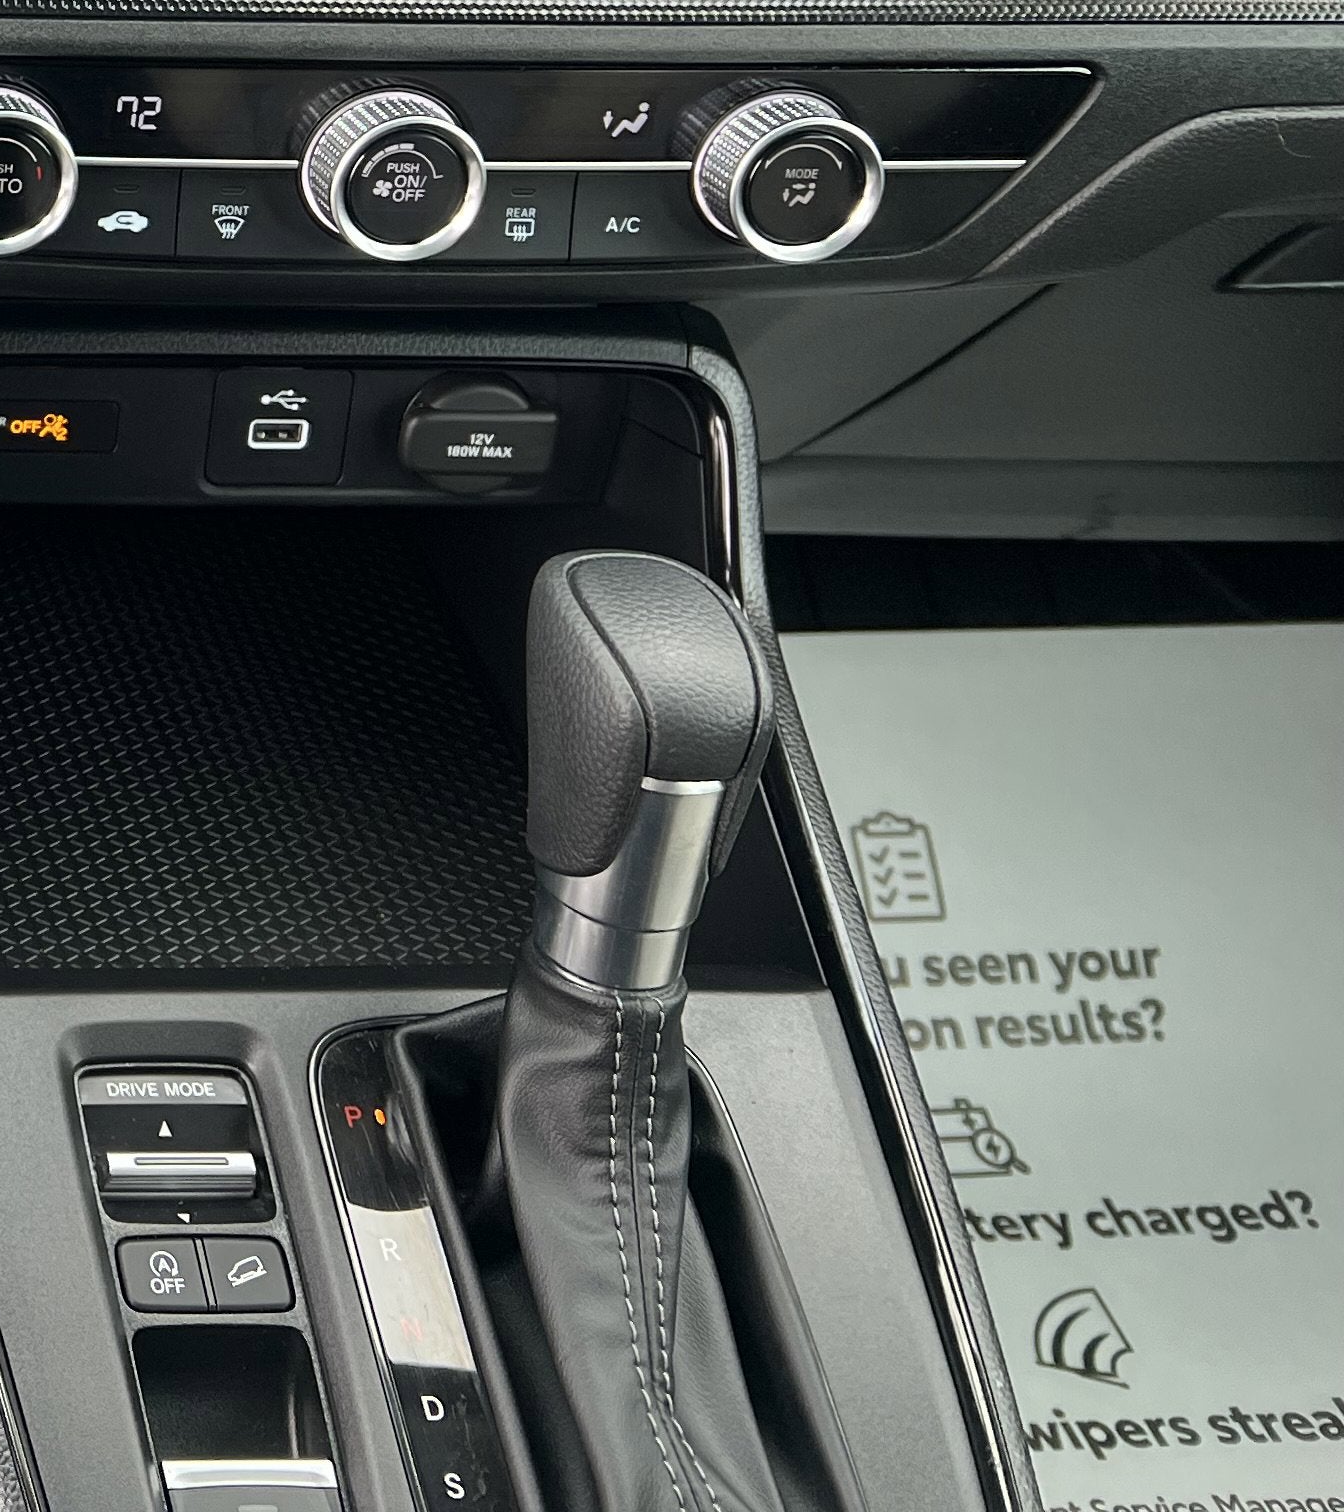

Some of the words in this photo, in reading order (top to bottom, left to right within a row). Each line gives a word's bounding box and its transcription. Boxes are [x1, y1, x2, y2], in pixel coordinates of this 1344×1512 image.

[116, 96, 163, 131] 72
[386, 162, 420, 174] PUSH
[785, 167, 819, 180] MODE
[392, 188, 427, 202] OFF
[212, 204, 250, 217] FRONT
[505, 207, 536, 219] REAR
[605, 216, 642, 235] A/C
[9, 419, 43, 435] OFF
[470, 432, 496, 446] 12V
[481, 445, 513, 459] MAX
[923, 949, 1040, 988] seen
[1050, 946, 1163, 994] your
[976, 998, 1167, 1049] results?
[106, 1081, 159, 1097] DRIVE
[164, 1081, 216, 1097] MODE
[343, 1104, 362, 1129] P
[1085, 1188, 1320, 1245] charged?
[382, 1240, 402, 1262] R
[150, 1277, 186, 1296] OFF
[401, 1319, 423, 1342] N
[420, 1394, 445, 1422] D
[1024, 1408, 1203, 1462] wipers
[443, 1472, 465, 1500] S
